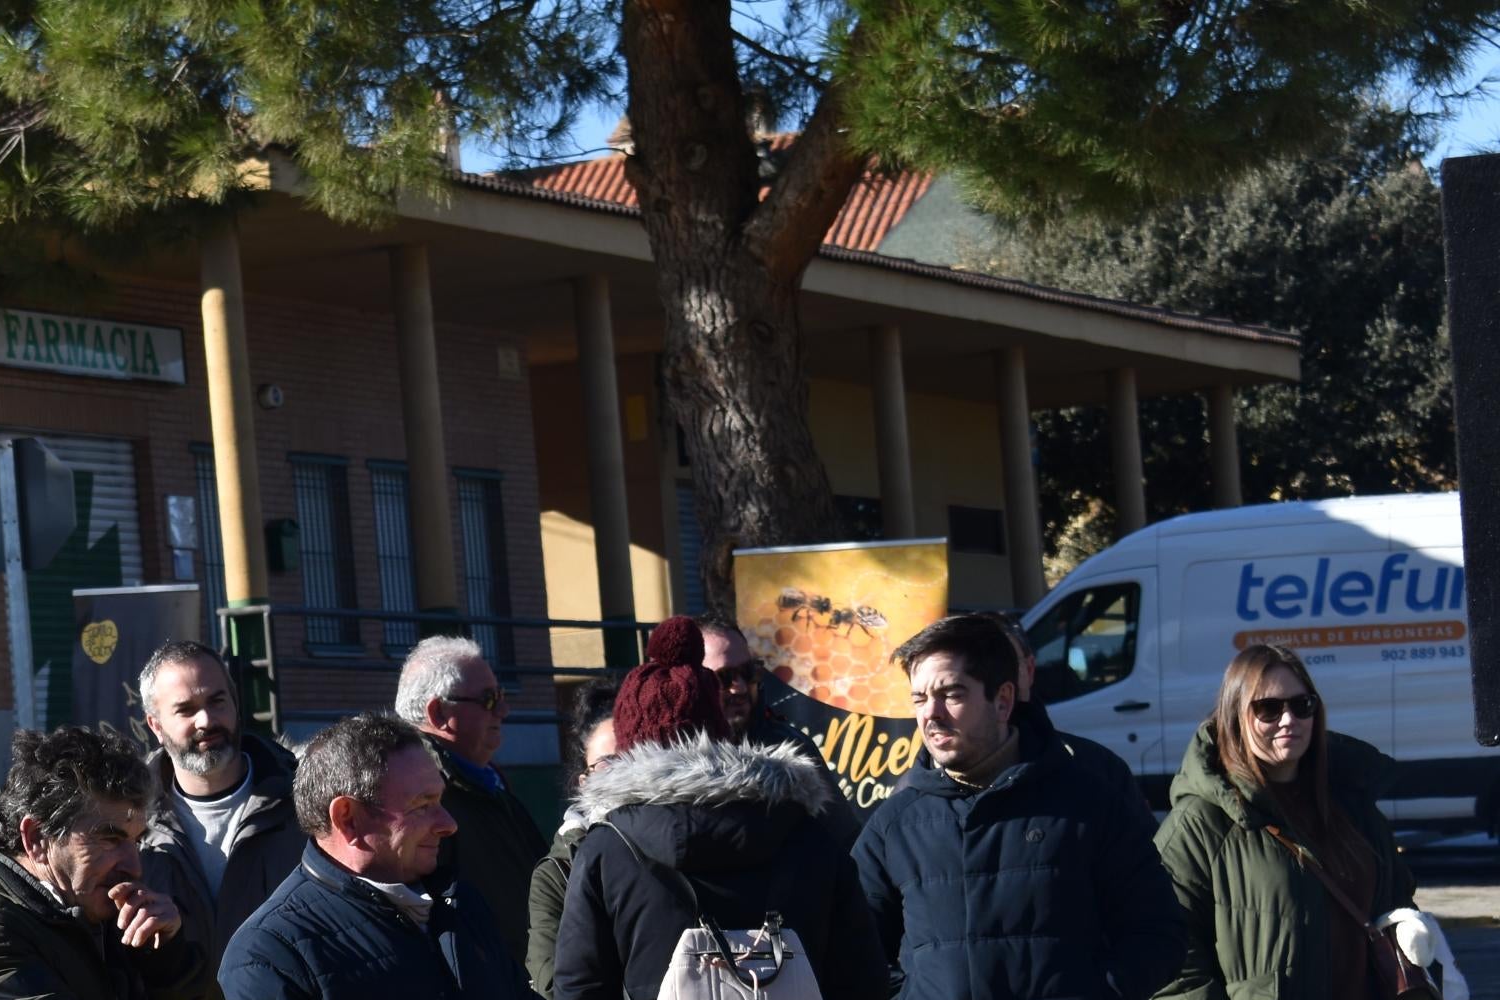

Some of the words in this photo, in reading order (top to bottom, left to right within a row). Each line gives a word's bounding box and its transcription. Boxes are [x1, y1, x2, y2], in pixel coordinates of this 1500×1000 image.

[3, 313, 160, 376] FARMACIA
[1328, 629, 1345, 642] DE
[1352, 625, 1454, 640] FURGONETAS
[1380, 648, 1406, 661] 902
[1410, 647, 1436, 660] 889
[1439, 645, 1465, 658] 943
